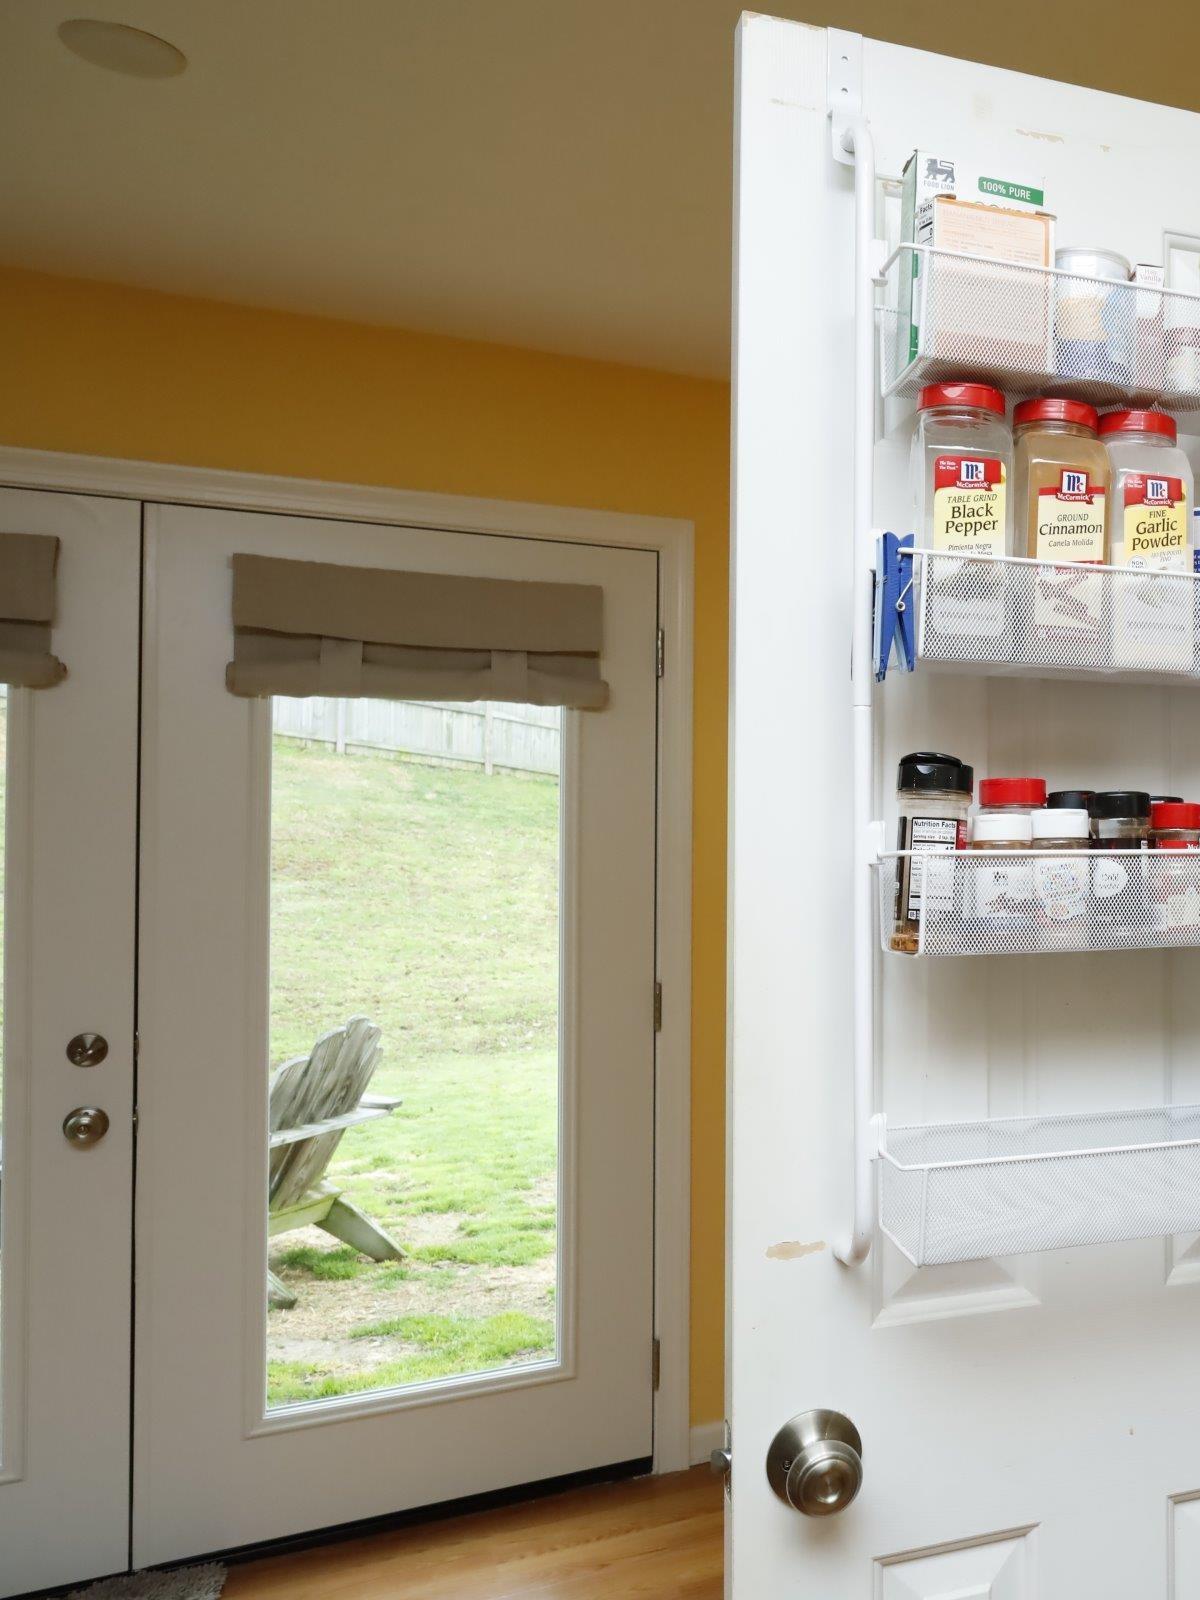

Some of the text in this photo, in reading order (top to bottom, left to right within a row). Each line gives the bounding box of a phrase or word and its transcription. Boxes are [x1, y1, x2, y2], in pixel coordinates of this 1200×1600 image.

[983, 181, 1031, 200] 100% PURE
[956, 480, 989, 488] McCormick
[947, 493, 997, 503] TABLE GRIND
[1057, 492, 1090, 501] McCormick
[951, 503, 993, 519] Black
[1149, 510, 1167, 518] FINE
[1057, 513, 1089, 522] GROUND
[945, 520, 998, 536] Pepper
[1039, 522, 1103, 536] Cinnamon
[1136, 518, 1177, 535] Garlic
[975, 543, 992, 551] Negra
[1132, 533, 1182, 551] Powder
[941, 821, 955, 829] Facts
